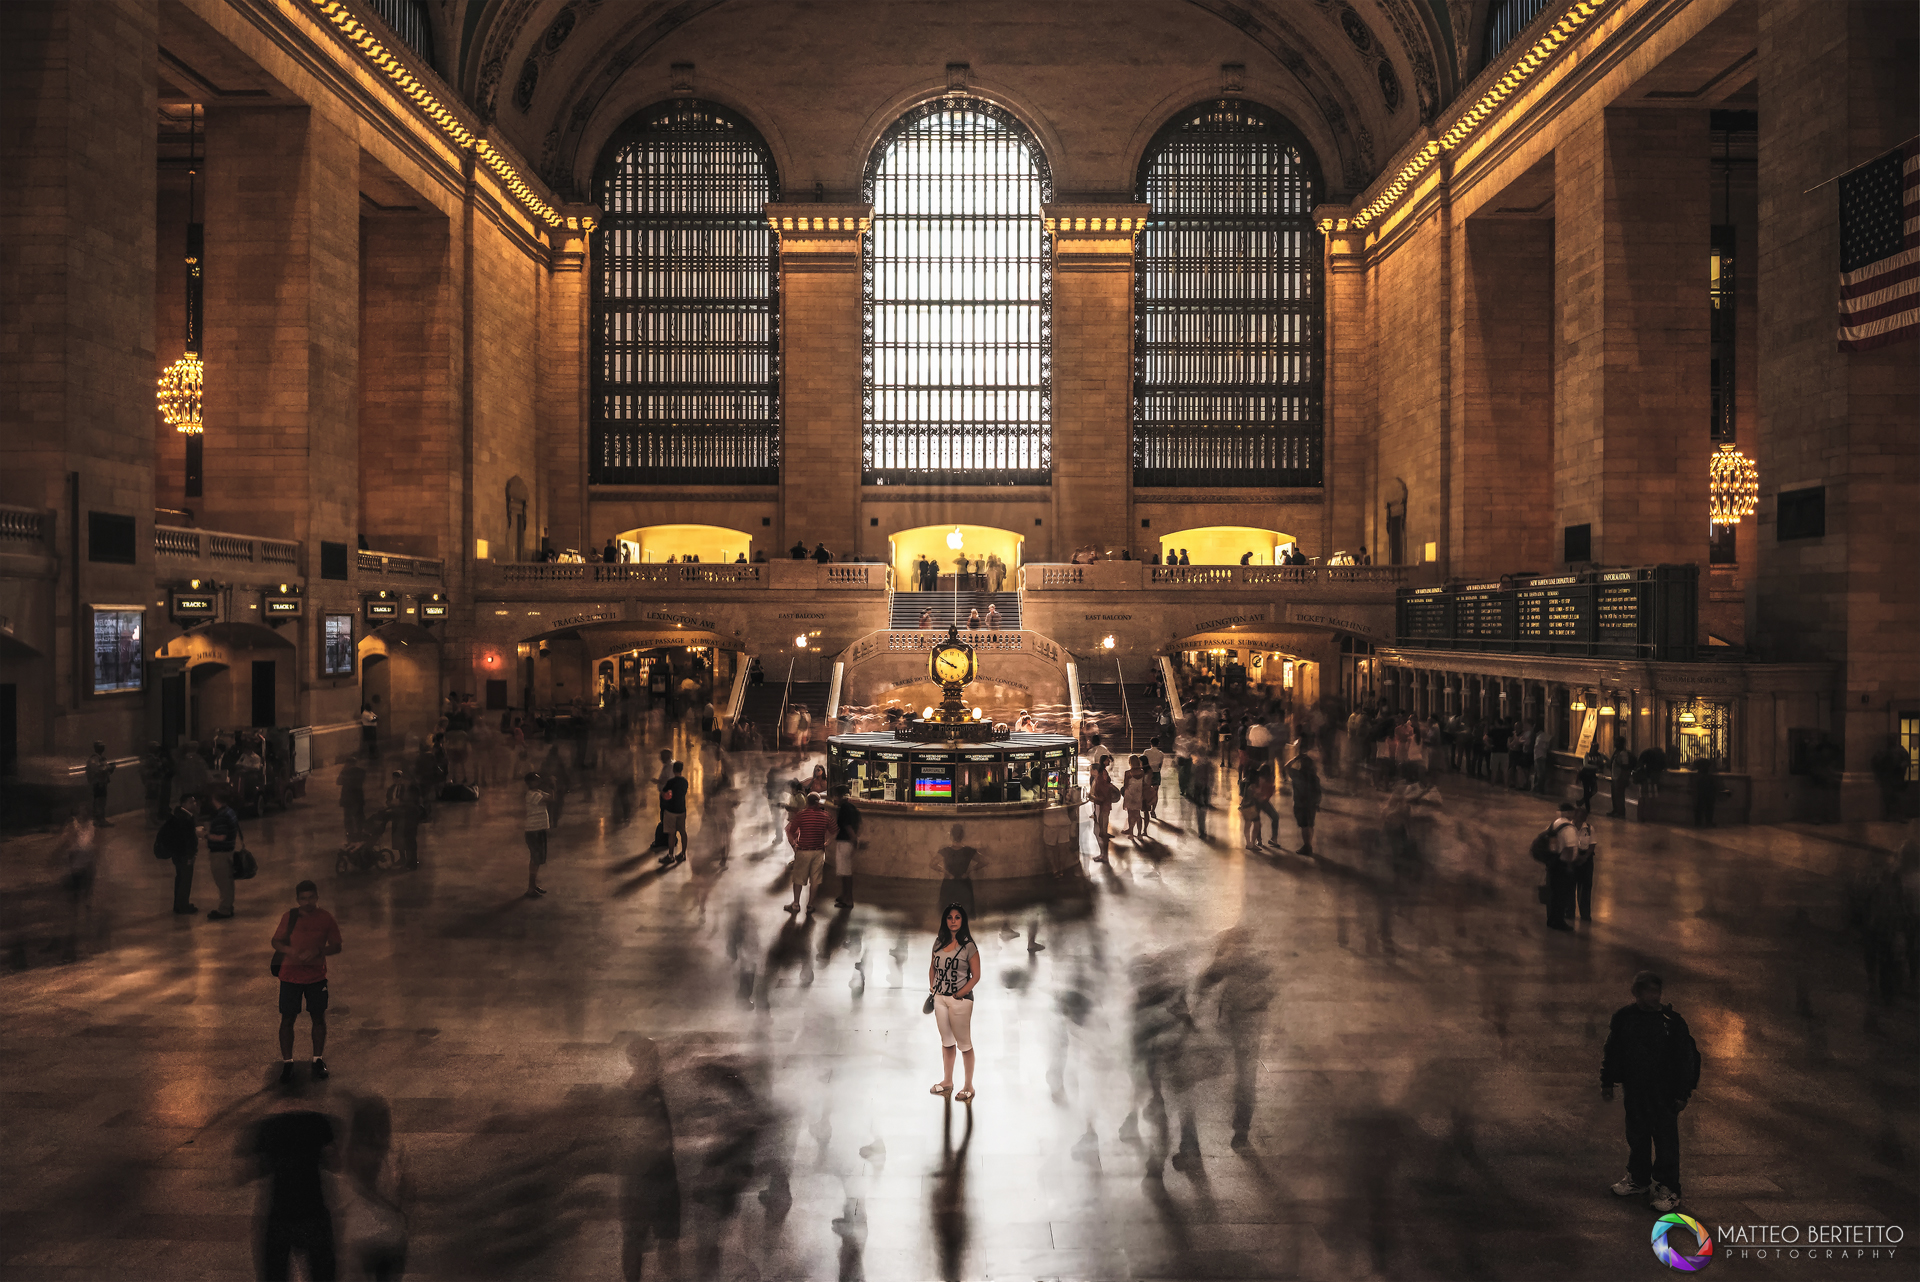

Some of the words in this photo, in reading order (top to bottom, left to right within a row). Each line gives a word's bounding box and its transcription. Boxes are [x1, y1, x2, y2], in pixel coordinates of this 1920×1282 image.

[552, 616, 584, 628] TRACKS
[646, 612, 697, 626] LEXINGTON
[699, 620, 716, 629] AVE
[1195, 615, 1247, 631] LEXINGTON
[1249, 613, 1265, 621] AVE
[1296, 614, 1326, 623] TICKET
[1328, 617, 1372, 633] MACHINES
[628, 640, 653, 648] STREET
[691, 638, 719, 647] SUBWAY
[1176, 641, 1202, 650] STREET
[1238, 639, 1268, 648] SUBWAY
[975, 674, 995, 682] INING
[995, 678, 1029, 690] CONCOURSE
[1697, 676, 1728, 684] SERVICE
[945, 956, 959, 970] GO
